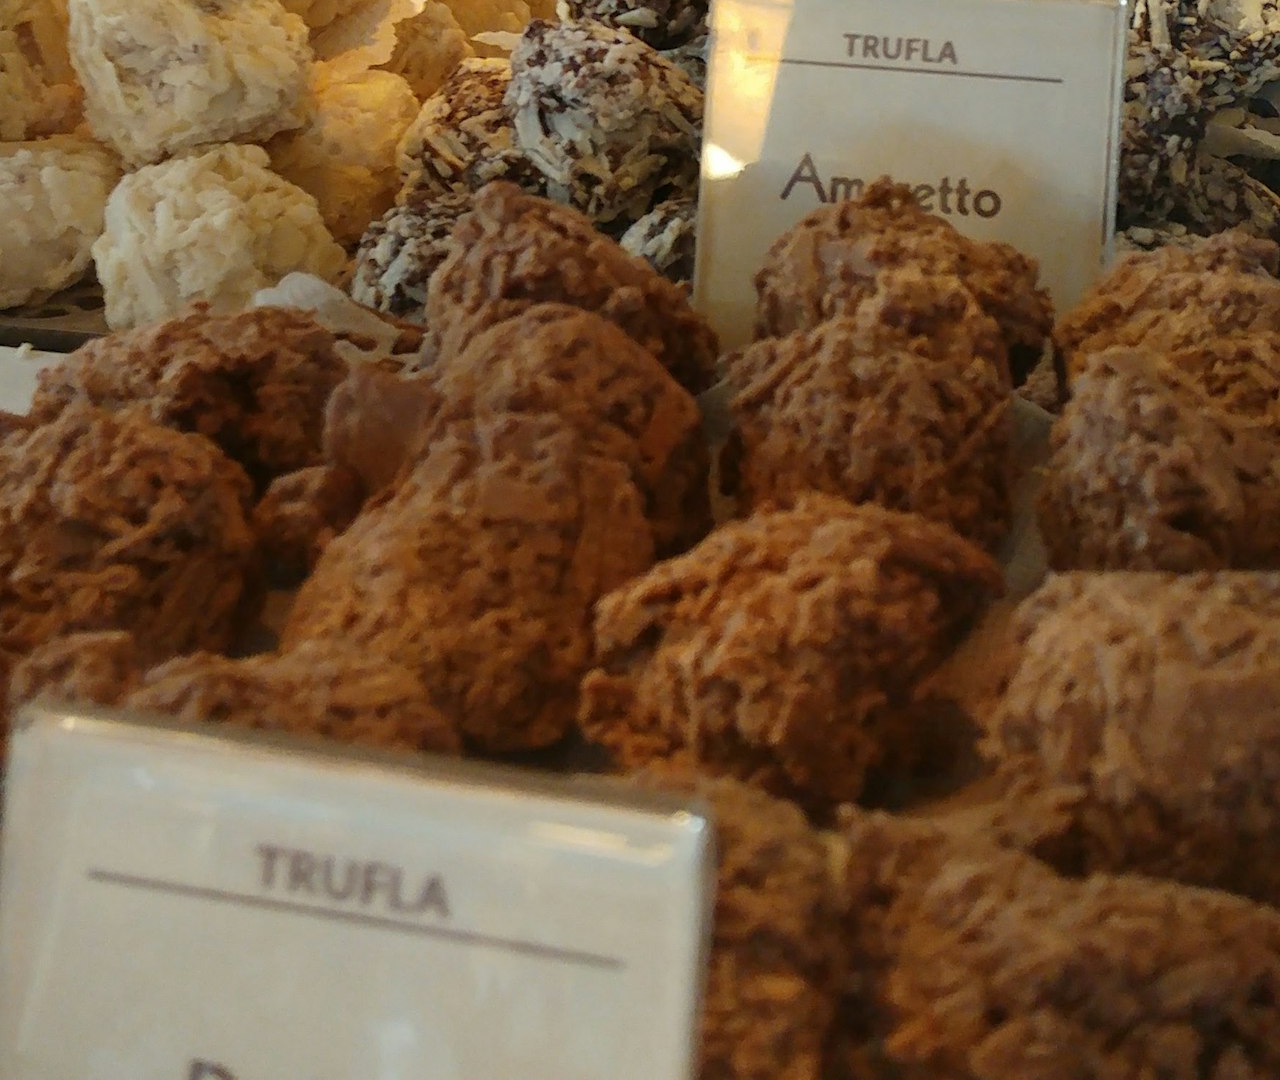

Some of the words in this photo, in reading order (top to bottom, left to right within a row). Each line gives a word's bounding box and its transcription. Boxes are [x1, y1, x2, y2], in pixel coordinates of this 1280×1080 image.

[843, 33, 959, 65] TRUFLA
[780, 152, 1002, 218] Ametto
[256, 843, 451, 919] TRUFLA
